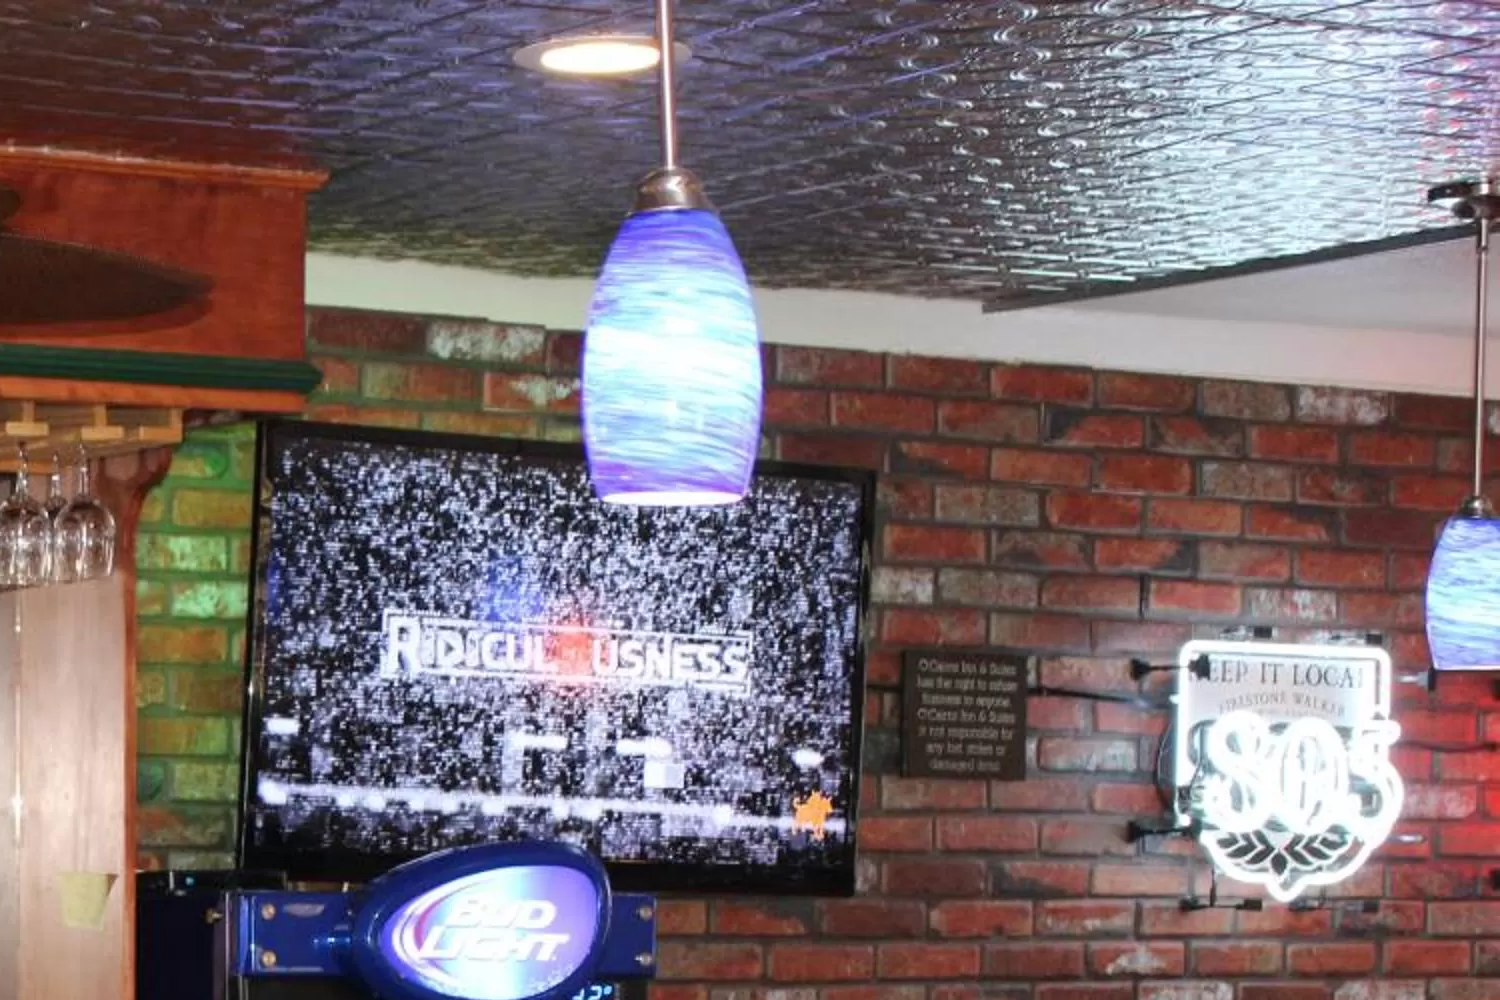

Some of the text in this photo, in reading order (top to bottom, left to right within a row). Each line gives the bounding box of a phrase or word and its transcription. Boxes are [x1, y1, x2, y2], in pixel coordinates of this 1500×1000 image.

[384, 615, 750, 682] RIDICULUSNESS
[1260, 662, 1284, 685] IT
[446, 898, 557, 928] BUD
[419, 925, 571, 961] LIGHT
